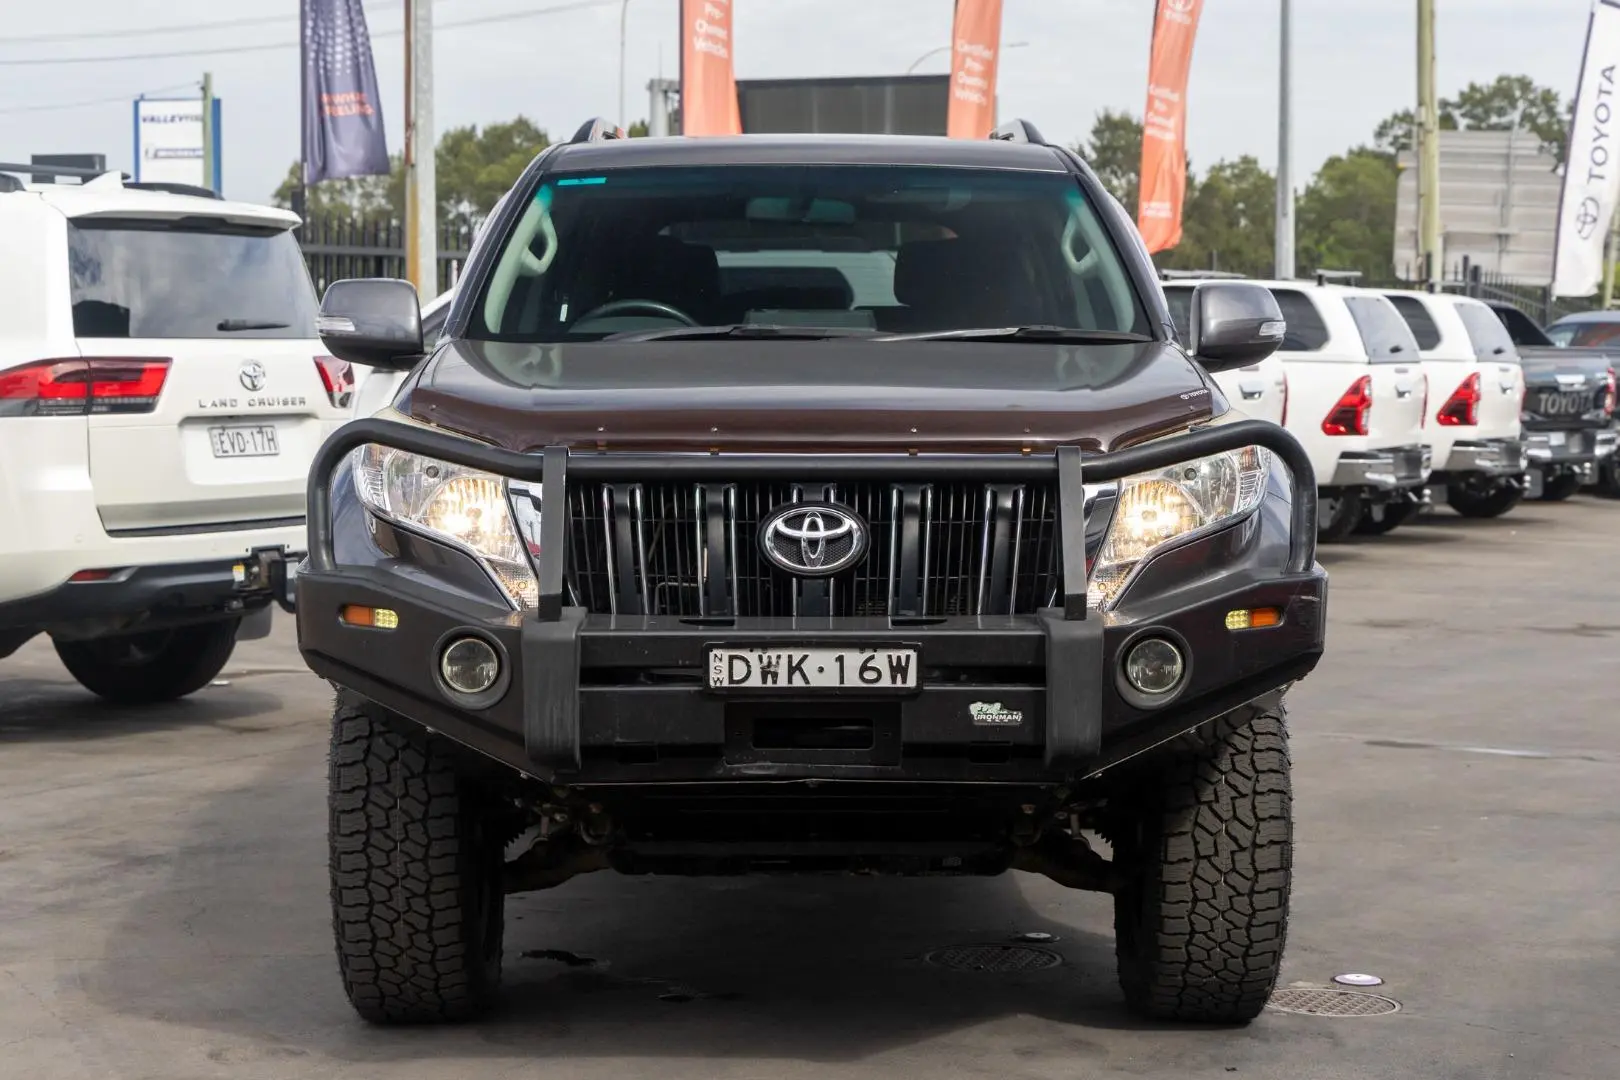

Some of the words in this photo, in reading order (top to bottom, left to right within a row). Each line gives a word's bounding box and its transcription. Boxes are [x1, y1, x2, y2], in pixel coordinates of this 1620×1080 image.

[1587, 64, 1617, 184] TOYOTA
[198, 398, 238, 409] LAND
[247, 397, 306, 408] CRUISER
